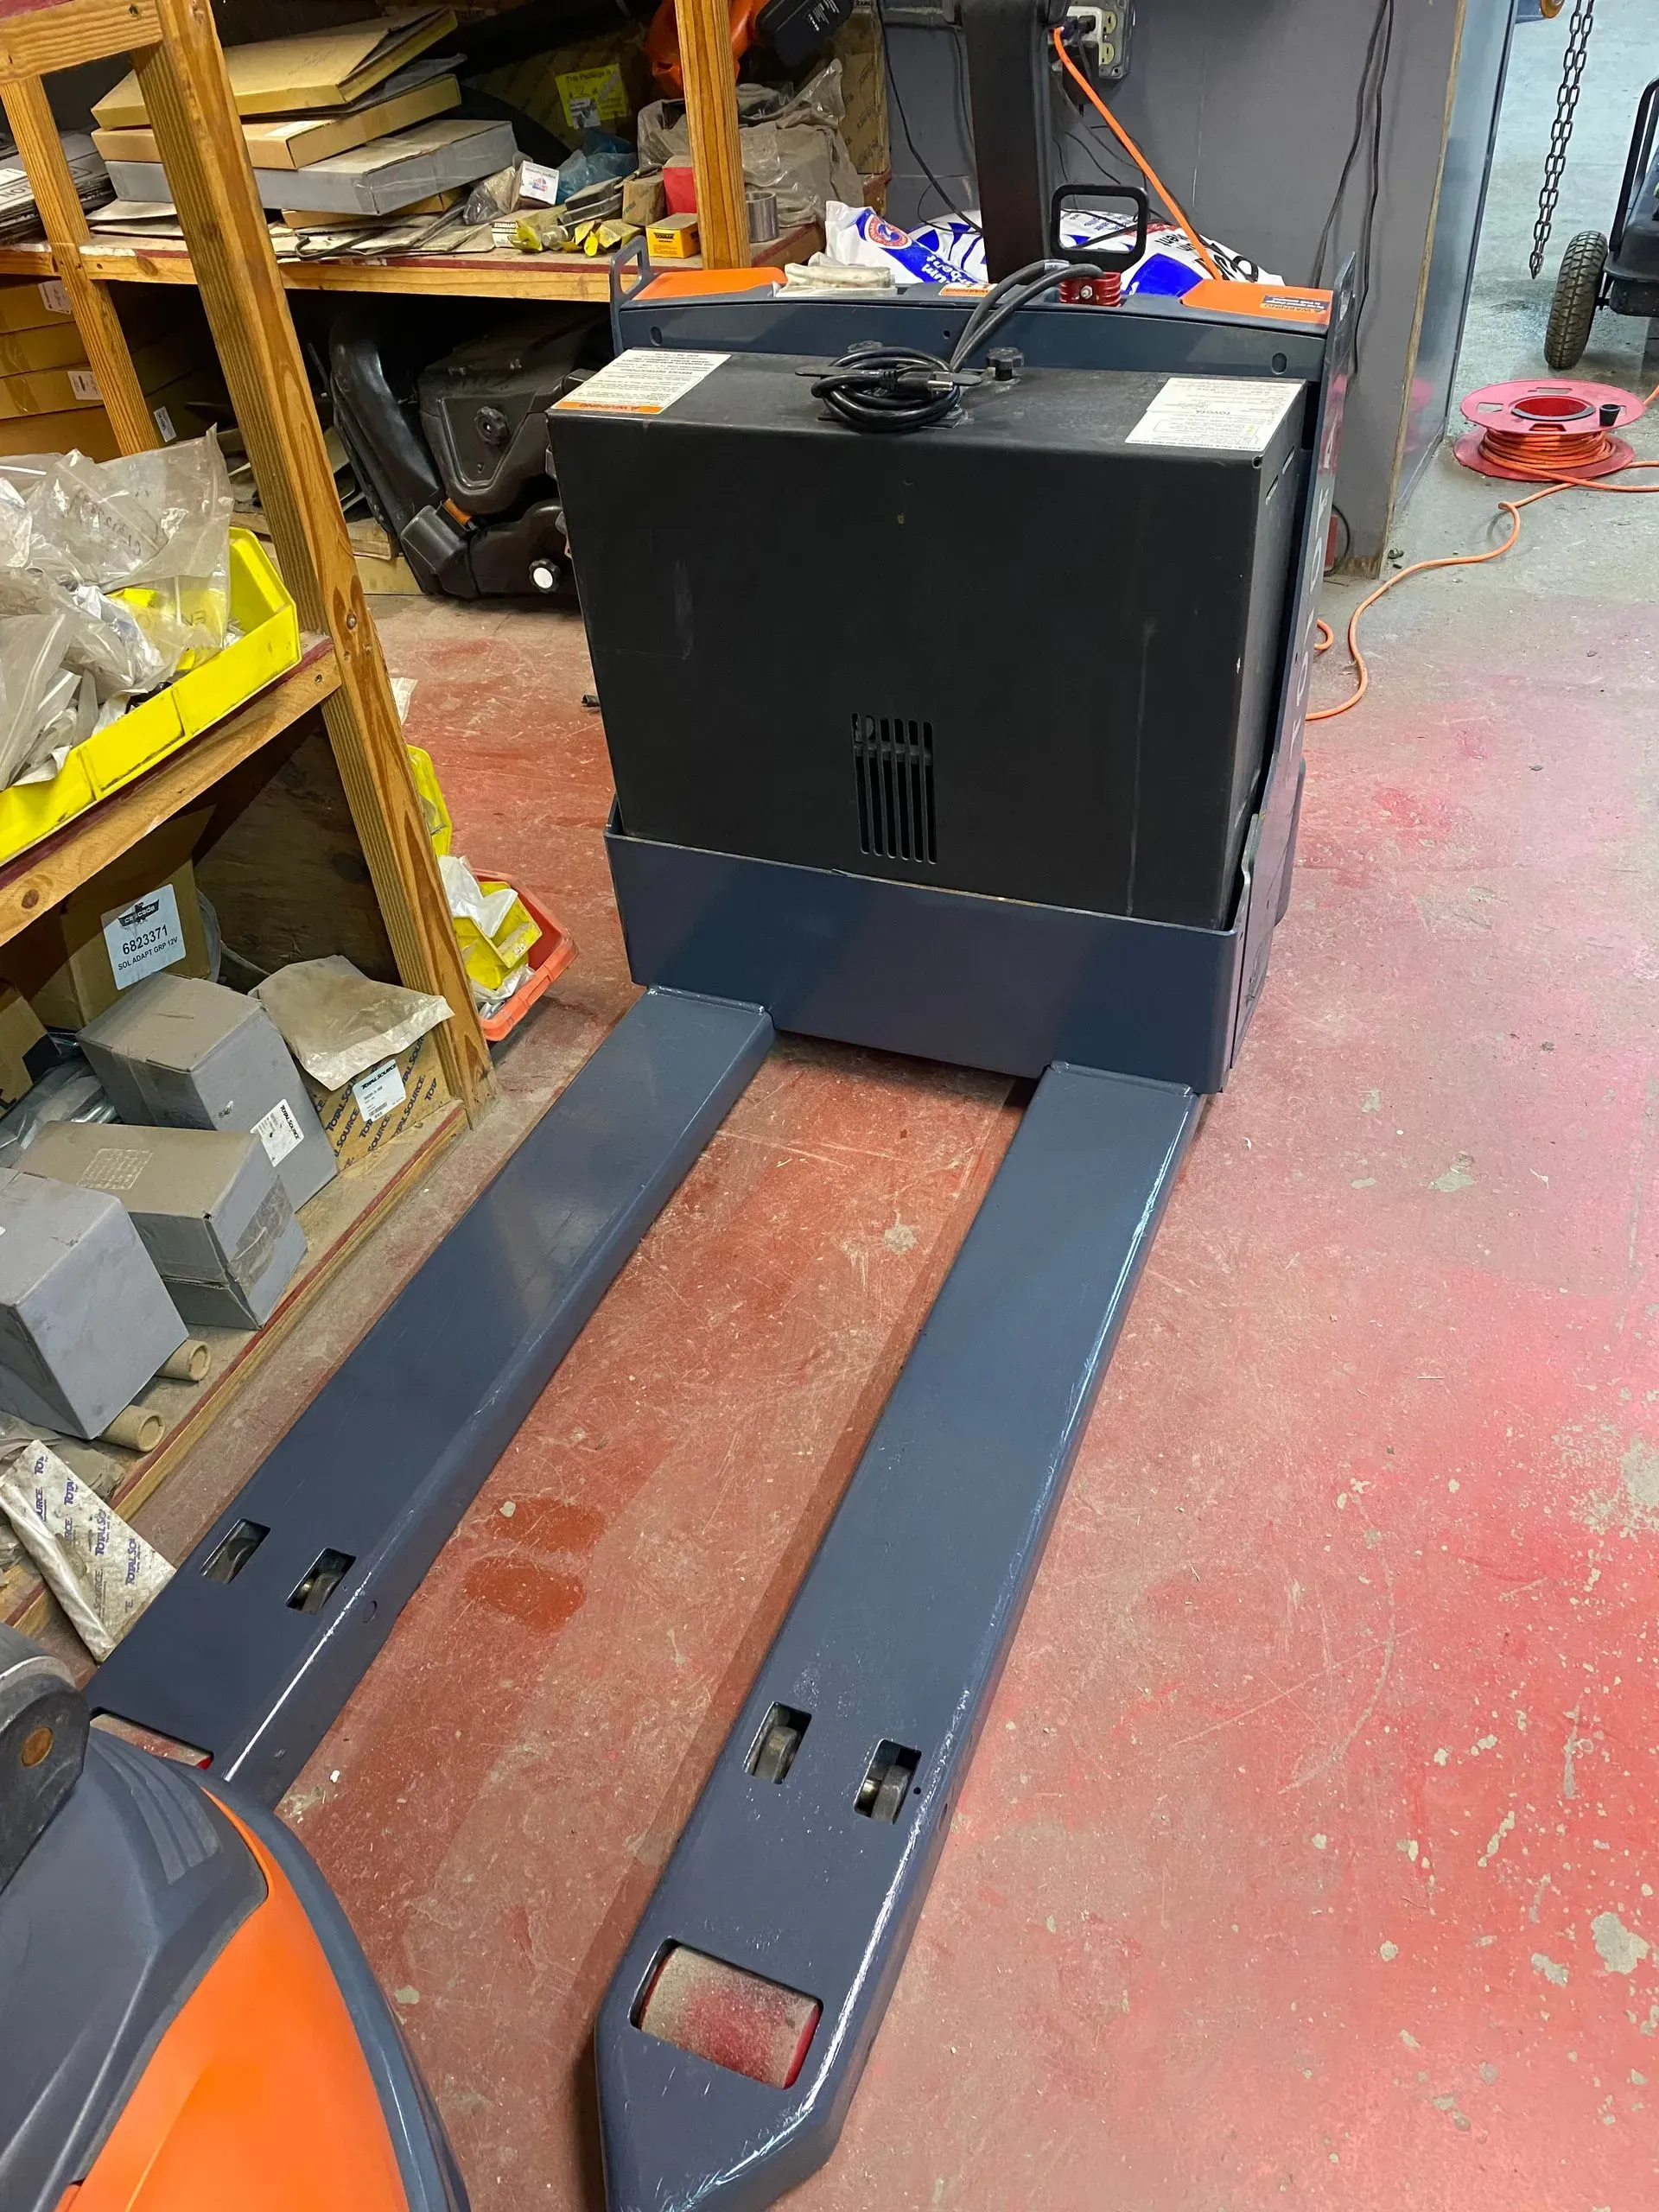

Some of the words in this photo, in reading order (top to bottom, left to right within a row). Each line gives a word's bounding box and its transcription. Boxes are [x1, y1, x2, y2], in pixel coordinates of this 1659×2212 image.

[118, 960, 132, 970] SOL
[132, 949, 153, 963] ADAPT
[153, 942, 167, 953] GRP
[167, 936, 178, 946] 12V
[122, 925, 168, 955] 6823371
[325, 1103, 346, 1132] TOTAL
[95, 1527, 105, 1555] TOTAL
[125, 1554, 137, 1586] TOTAL
